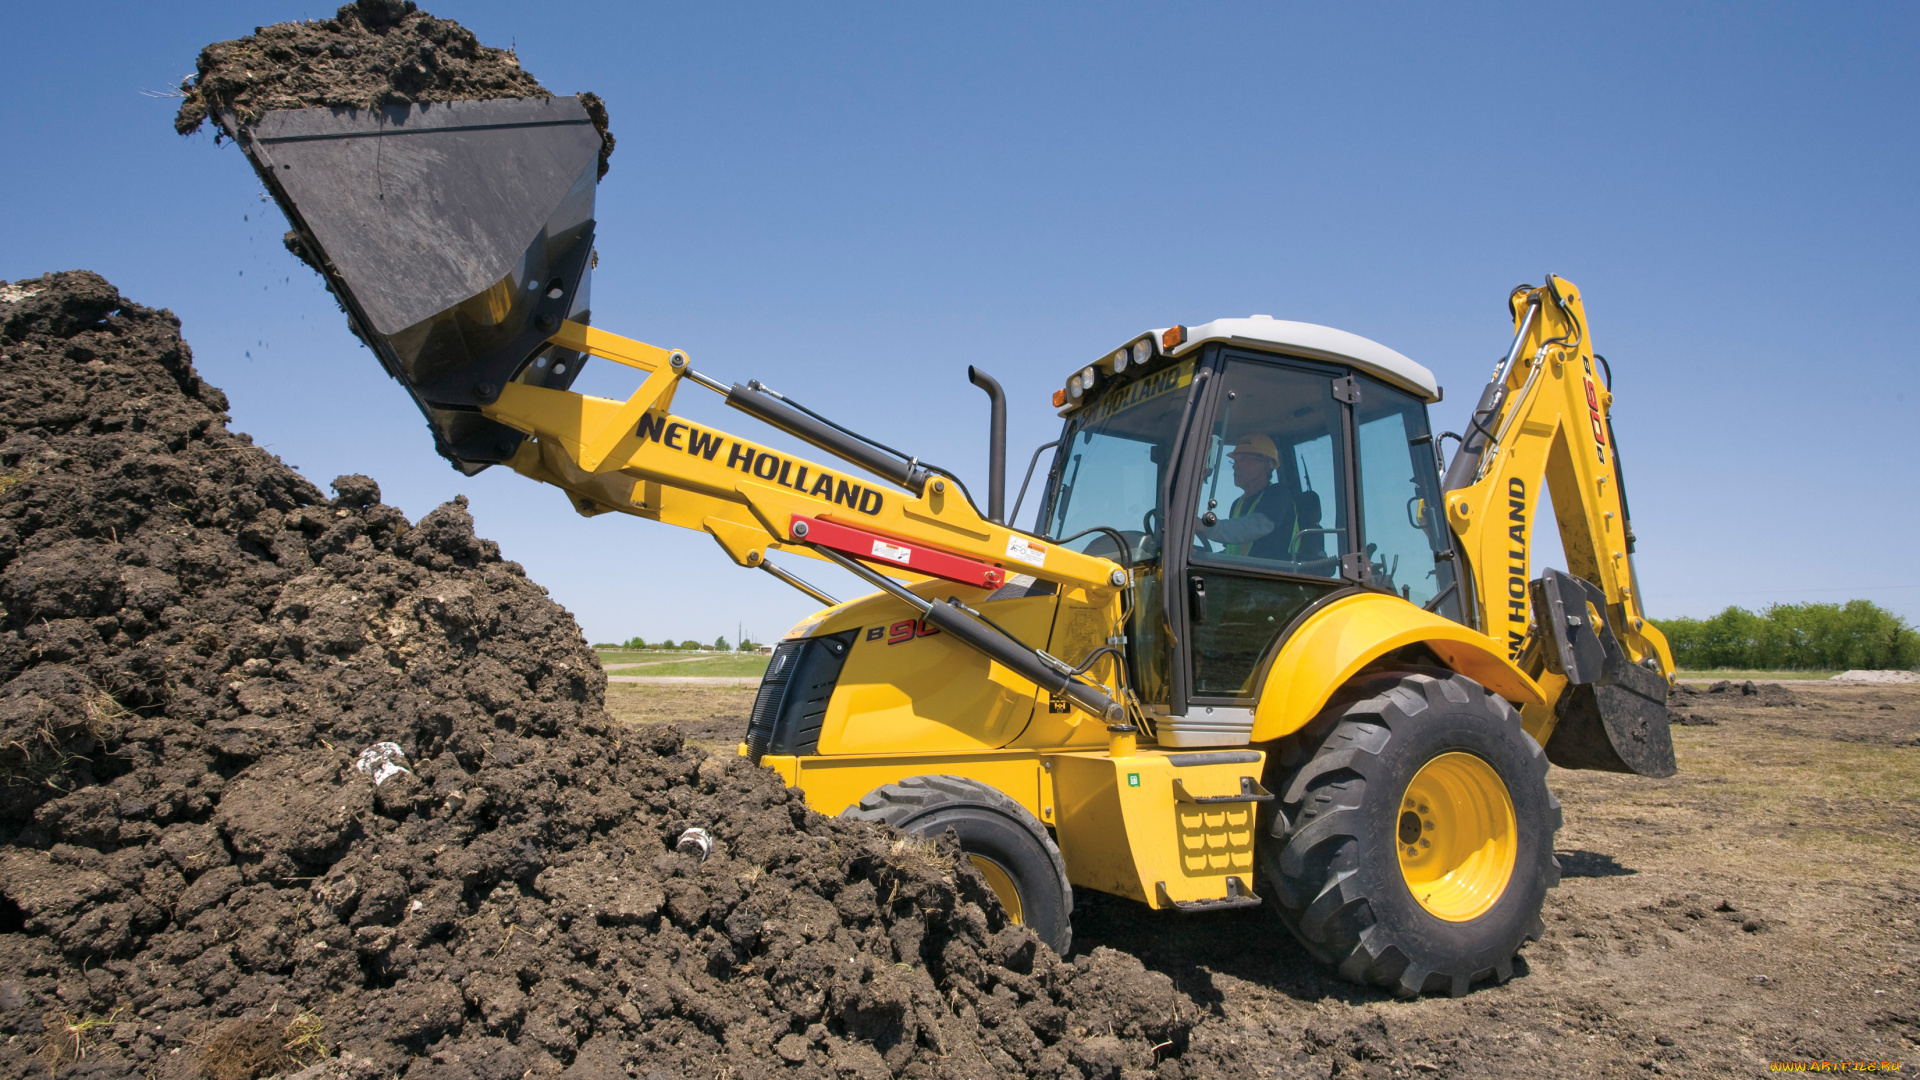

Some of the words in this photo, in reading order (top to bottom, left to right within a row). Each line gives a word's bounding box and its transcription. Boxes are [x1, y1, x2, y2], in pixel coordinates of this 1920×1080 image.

[1101, 366, 1182, 416] HOLLAND
[635, 412, 724, 462] NEW
[726, 442, 884, 516] HOLLAND
[1508, 477, 1526, 623] HOLLAND
